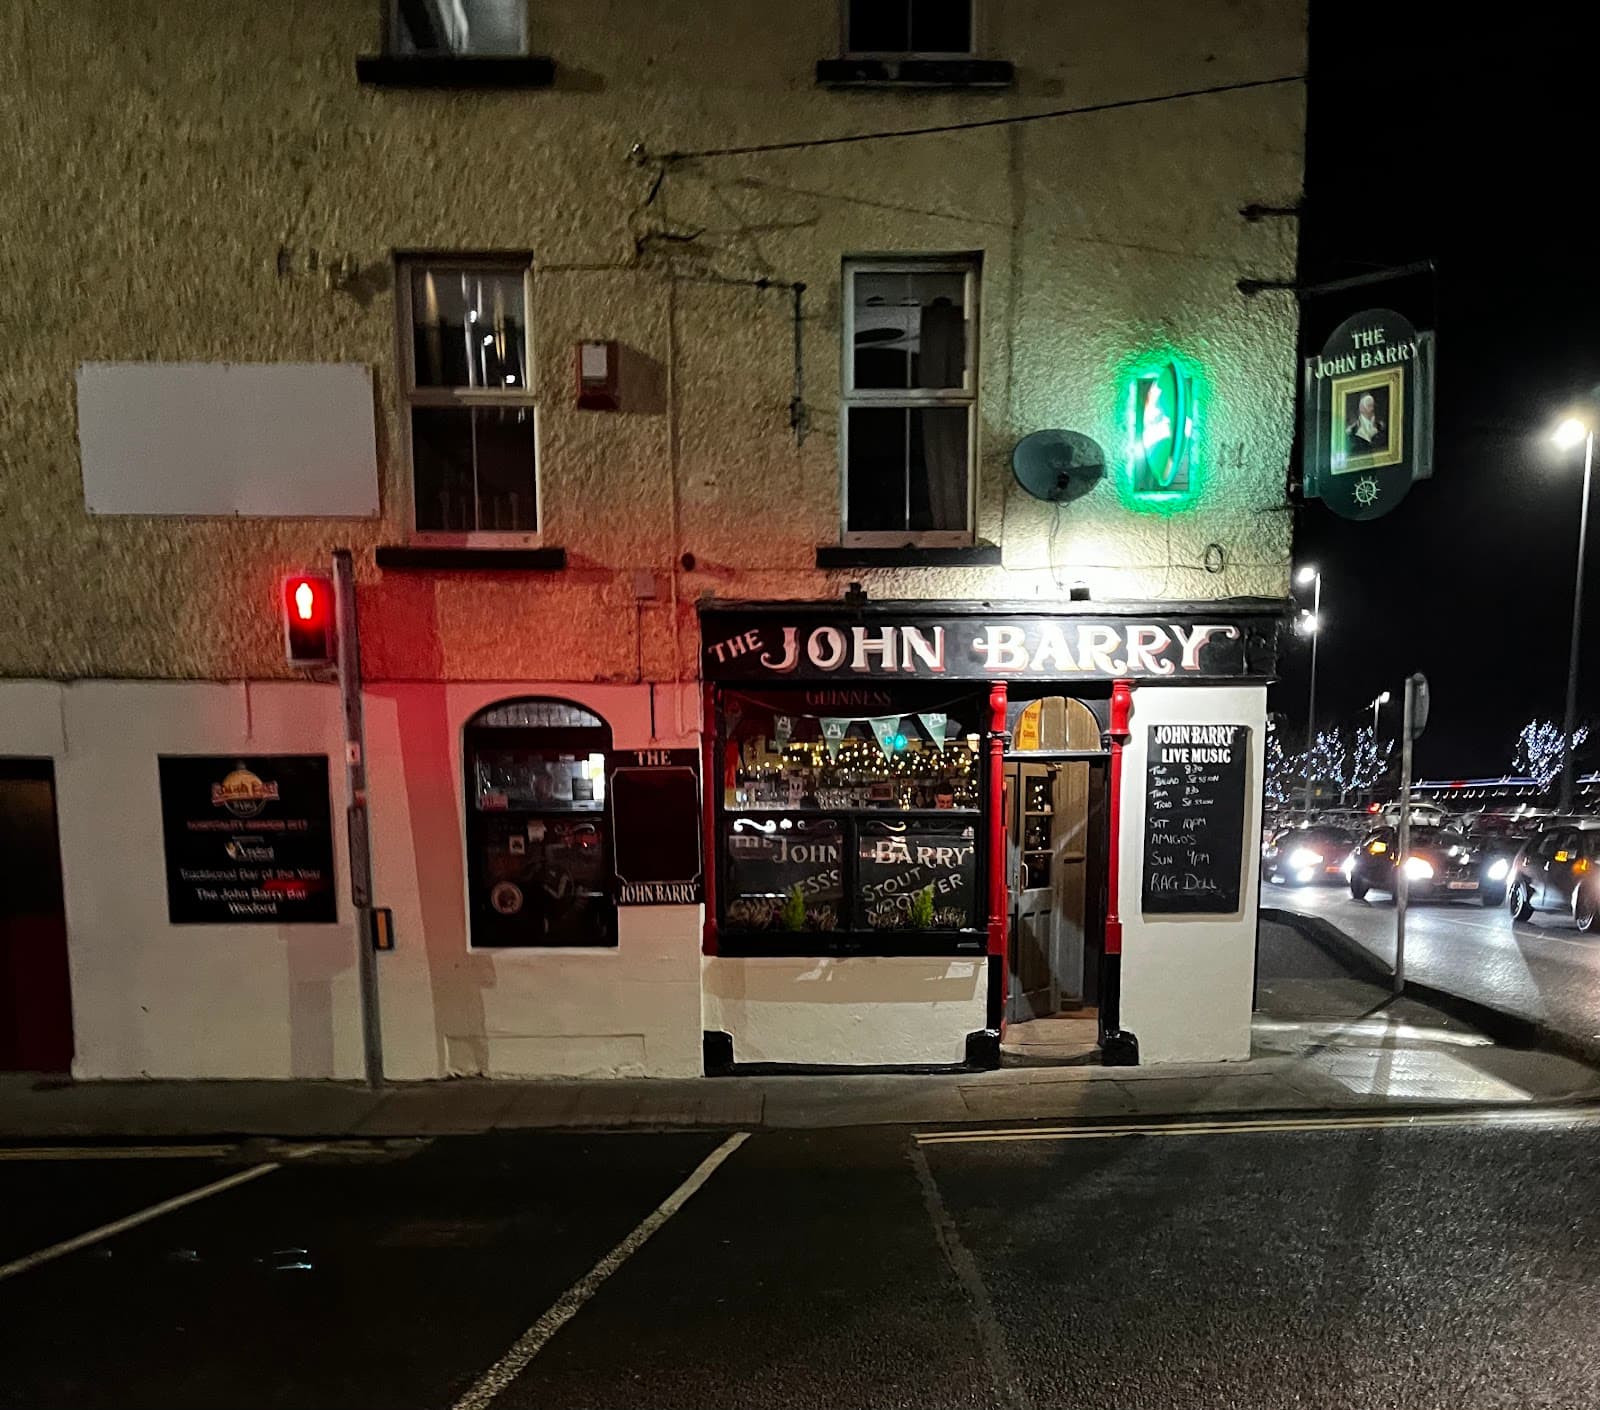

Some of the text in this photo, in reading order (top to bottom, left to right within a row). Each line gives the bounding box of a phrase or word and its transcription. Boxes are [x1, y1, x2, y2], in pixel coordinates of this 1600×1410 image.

[1352, 328, 1386, 350] THE
[1315, 339, 1421, 380] JOHN BARRY
[708, 624, 1240, 676] THE JOHN BARRY
[805, 689, 893, 705] GUINNESS
[1154, 726, 1238, 746] JOHN BARRY
[633, 751, 671, 766] THE
[1161, 748, 1231, 764] LIVE MUSIC
[772, 835, 843, 863] JOHN
[875, 841, 971, 869] BARRY
[619, 884, 700, 904] JOHN BARRY
[862, 867, 921, 902] STOUT
